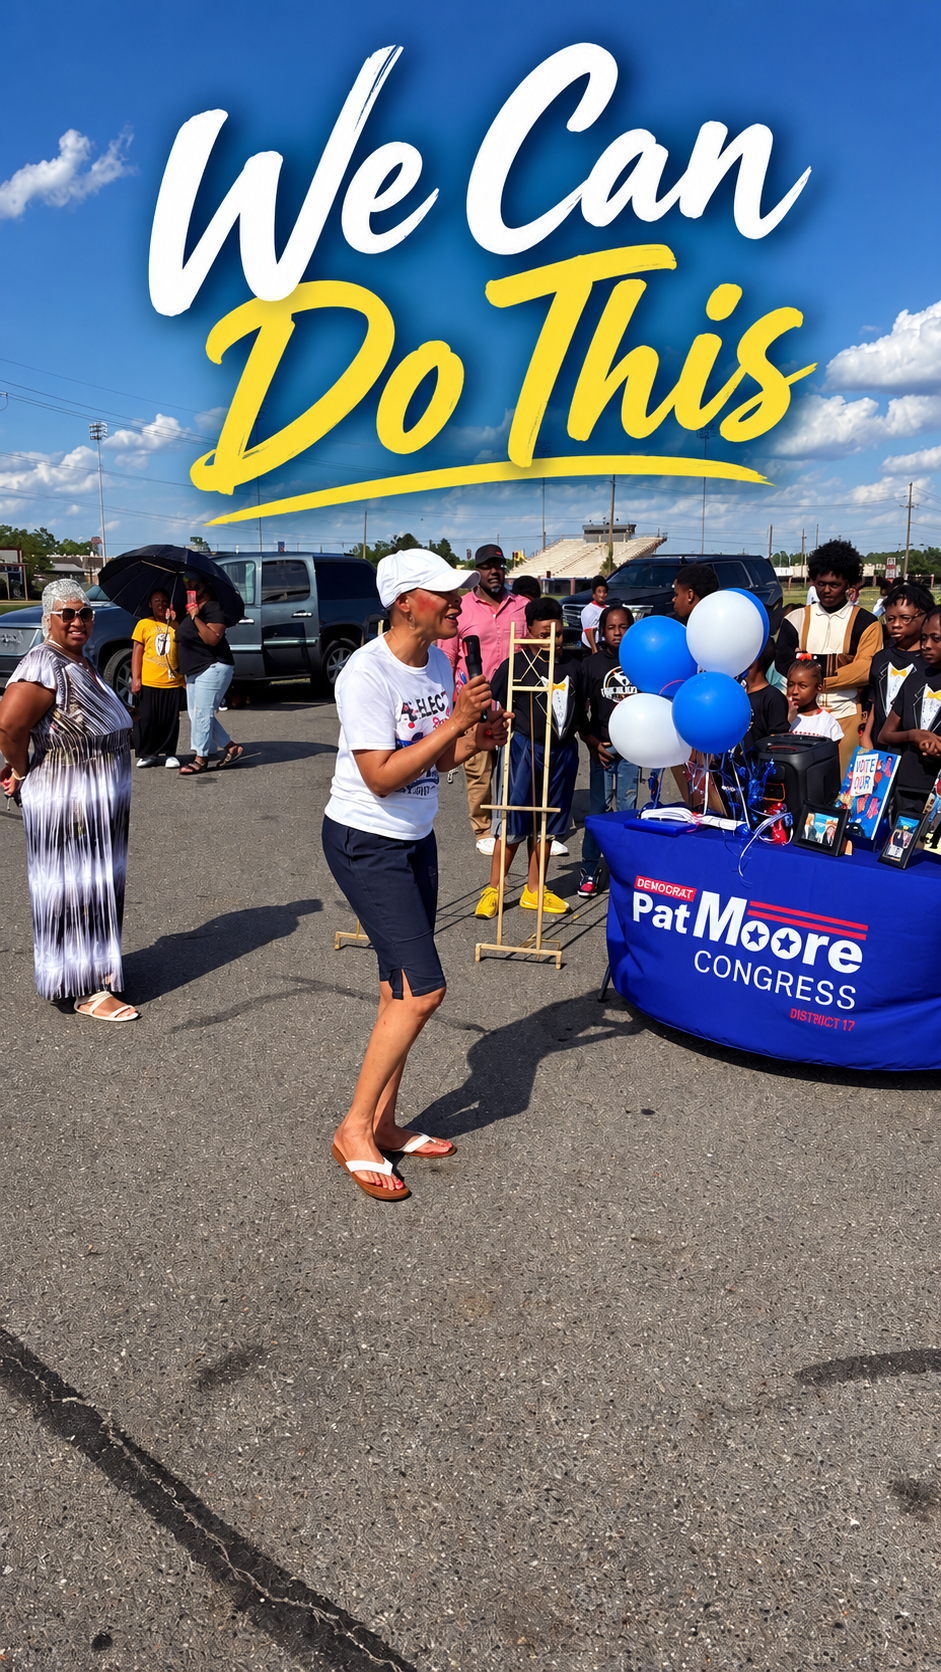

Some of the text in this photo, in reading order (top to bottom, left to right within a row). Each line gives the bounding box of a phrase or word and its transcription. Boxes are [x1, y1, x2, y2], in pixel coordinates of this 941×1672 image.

[636, 877, 694, 900] DEMOCRAT
[633, 890, 863, 974] Pat Moore
[694, 950, 856, 1010] CONGRESS
[790, 1008, 856, 1032] DISTRICT 17
